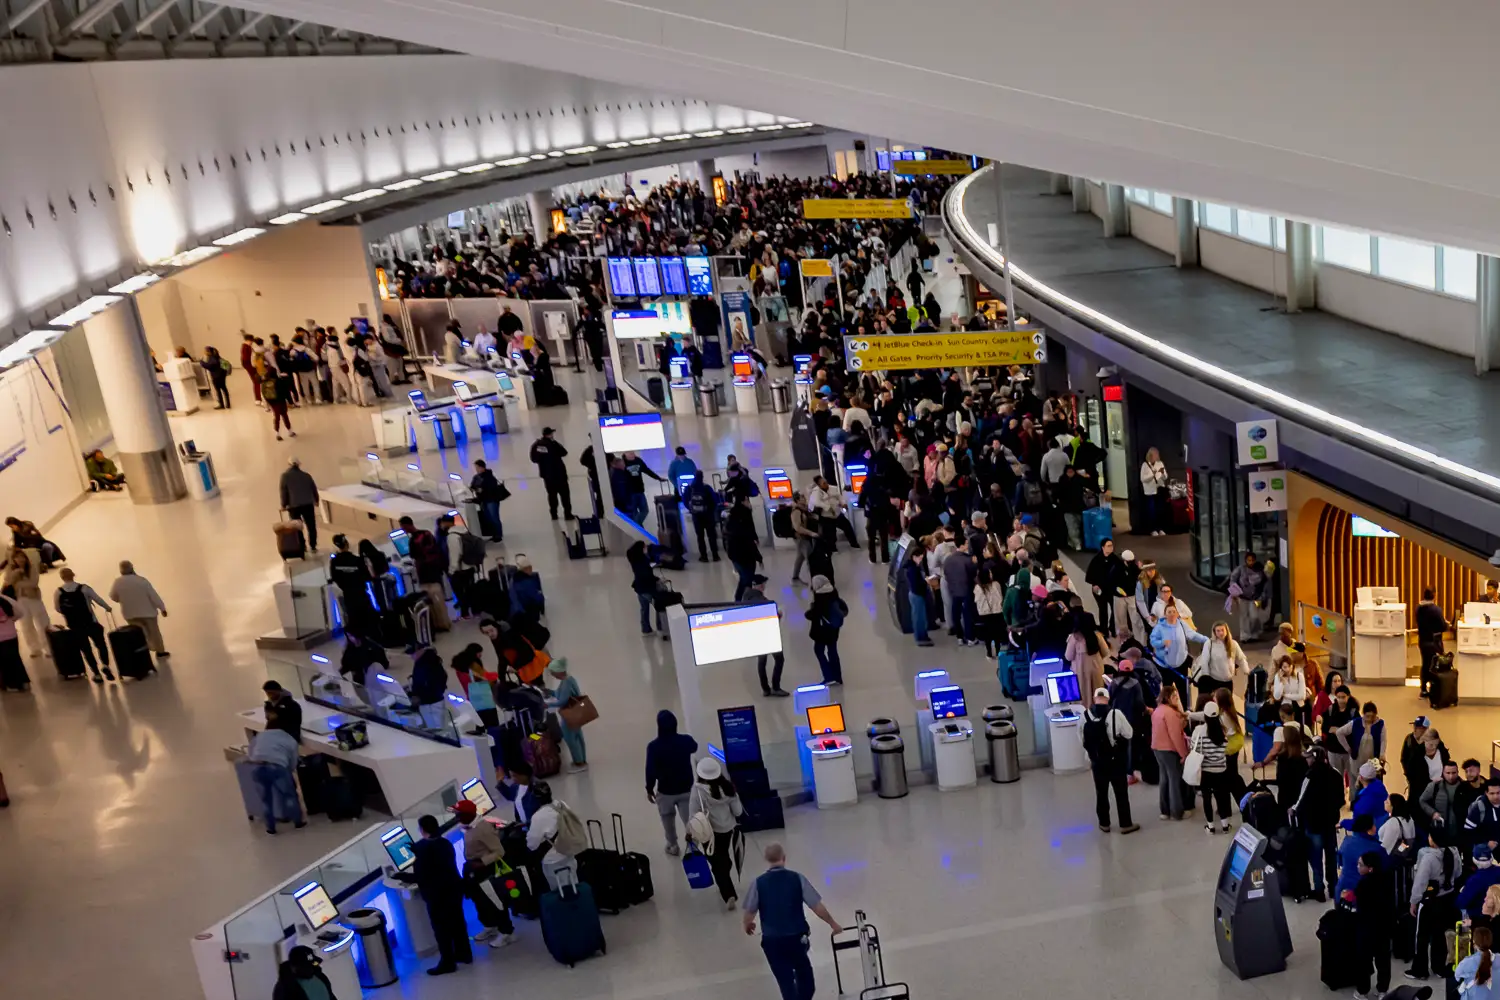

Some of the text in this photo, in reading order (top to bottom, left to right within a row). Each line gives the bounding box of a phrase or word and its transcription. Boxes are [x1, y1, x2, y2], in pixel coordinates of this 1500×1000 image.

[992, 336, 1008, 344] Cape
[916, 354, 943, 362] Priority
[944, 352, 973, 360] Security
